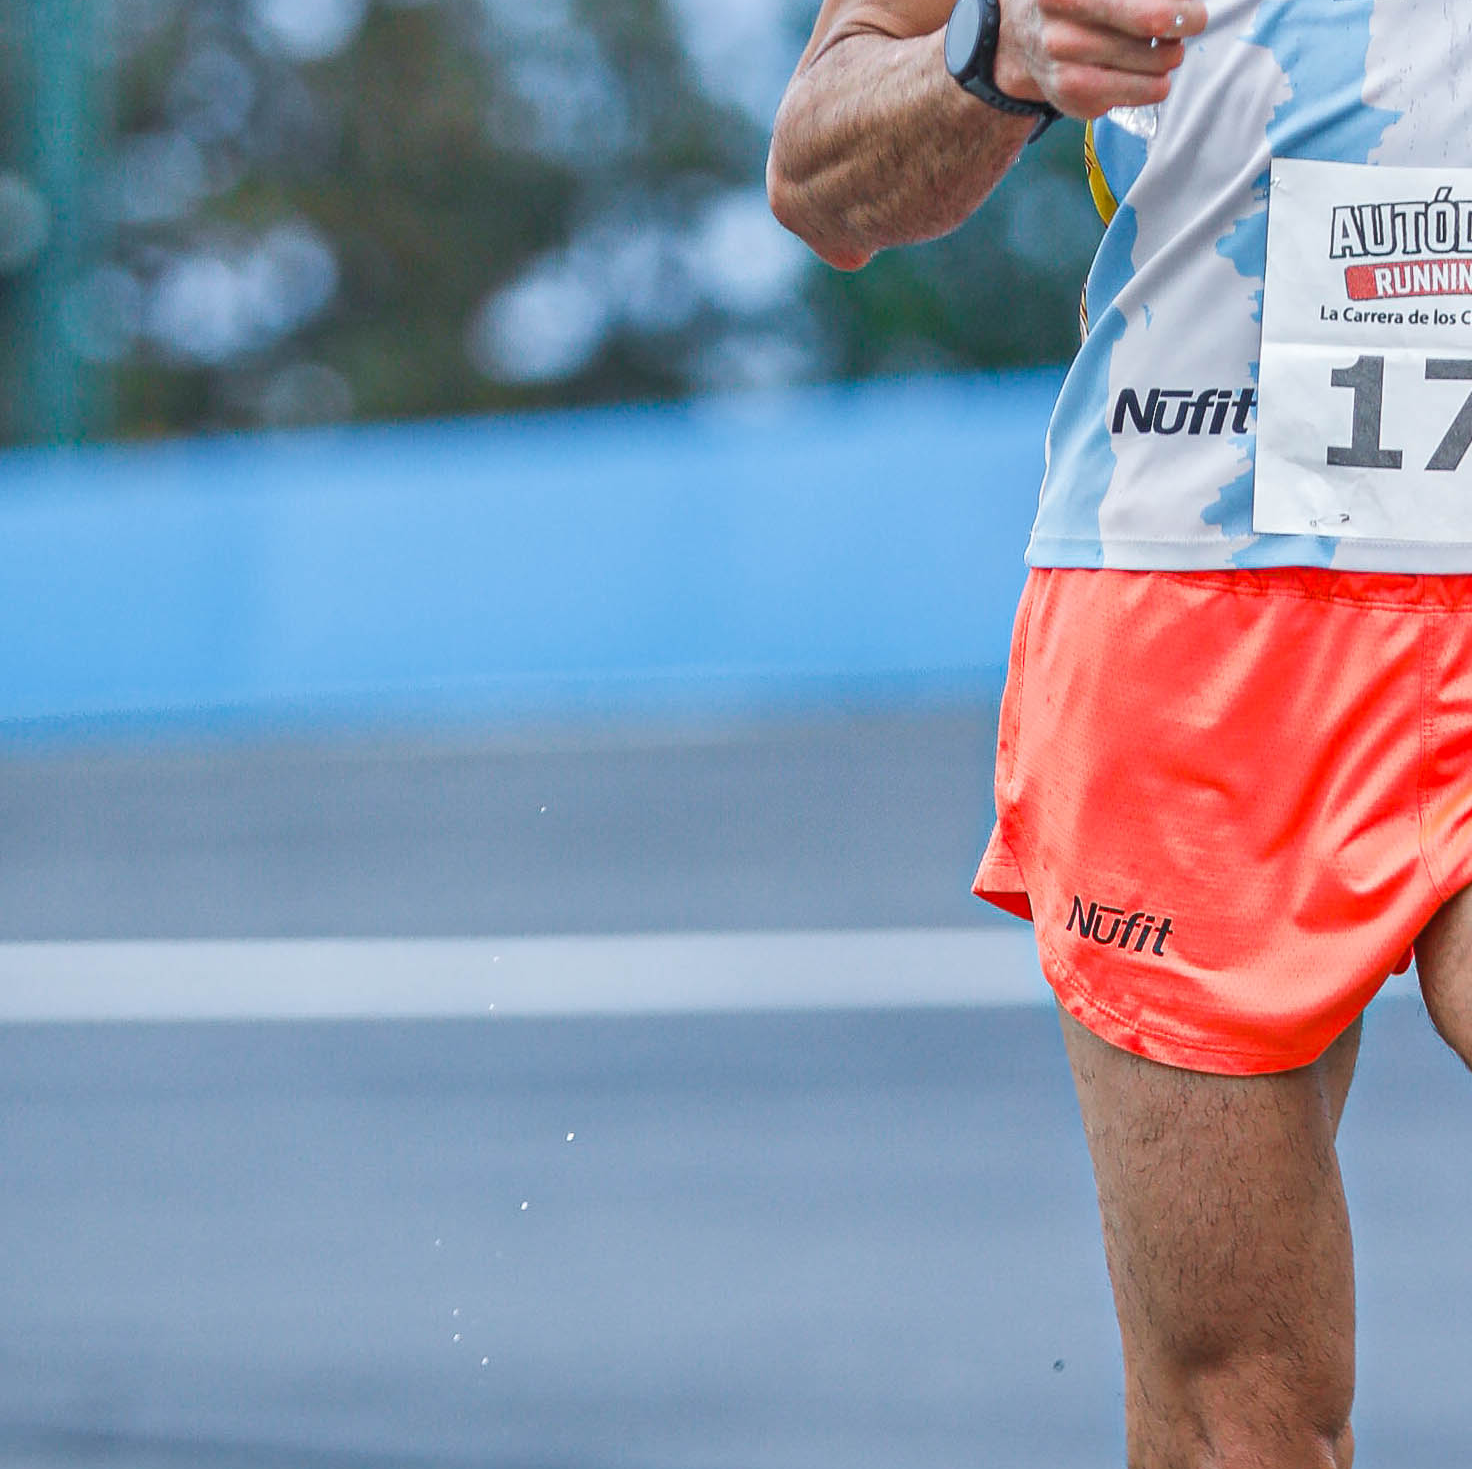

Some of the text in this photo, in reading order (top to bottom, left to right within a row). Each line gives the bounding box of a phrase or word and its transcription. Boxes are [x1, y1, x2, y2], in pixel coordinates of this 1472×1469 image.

[1320, 305, 1338, 321] La
[1343, 307, 1404, 324] Carrera
[1409, 309, 1429, 324] de
[1433, 308, 1457, 324] los
